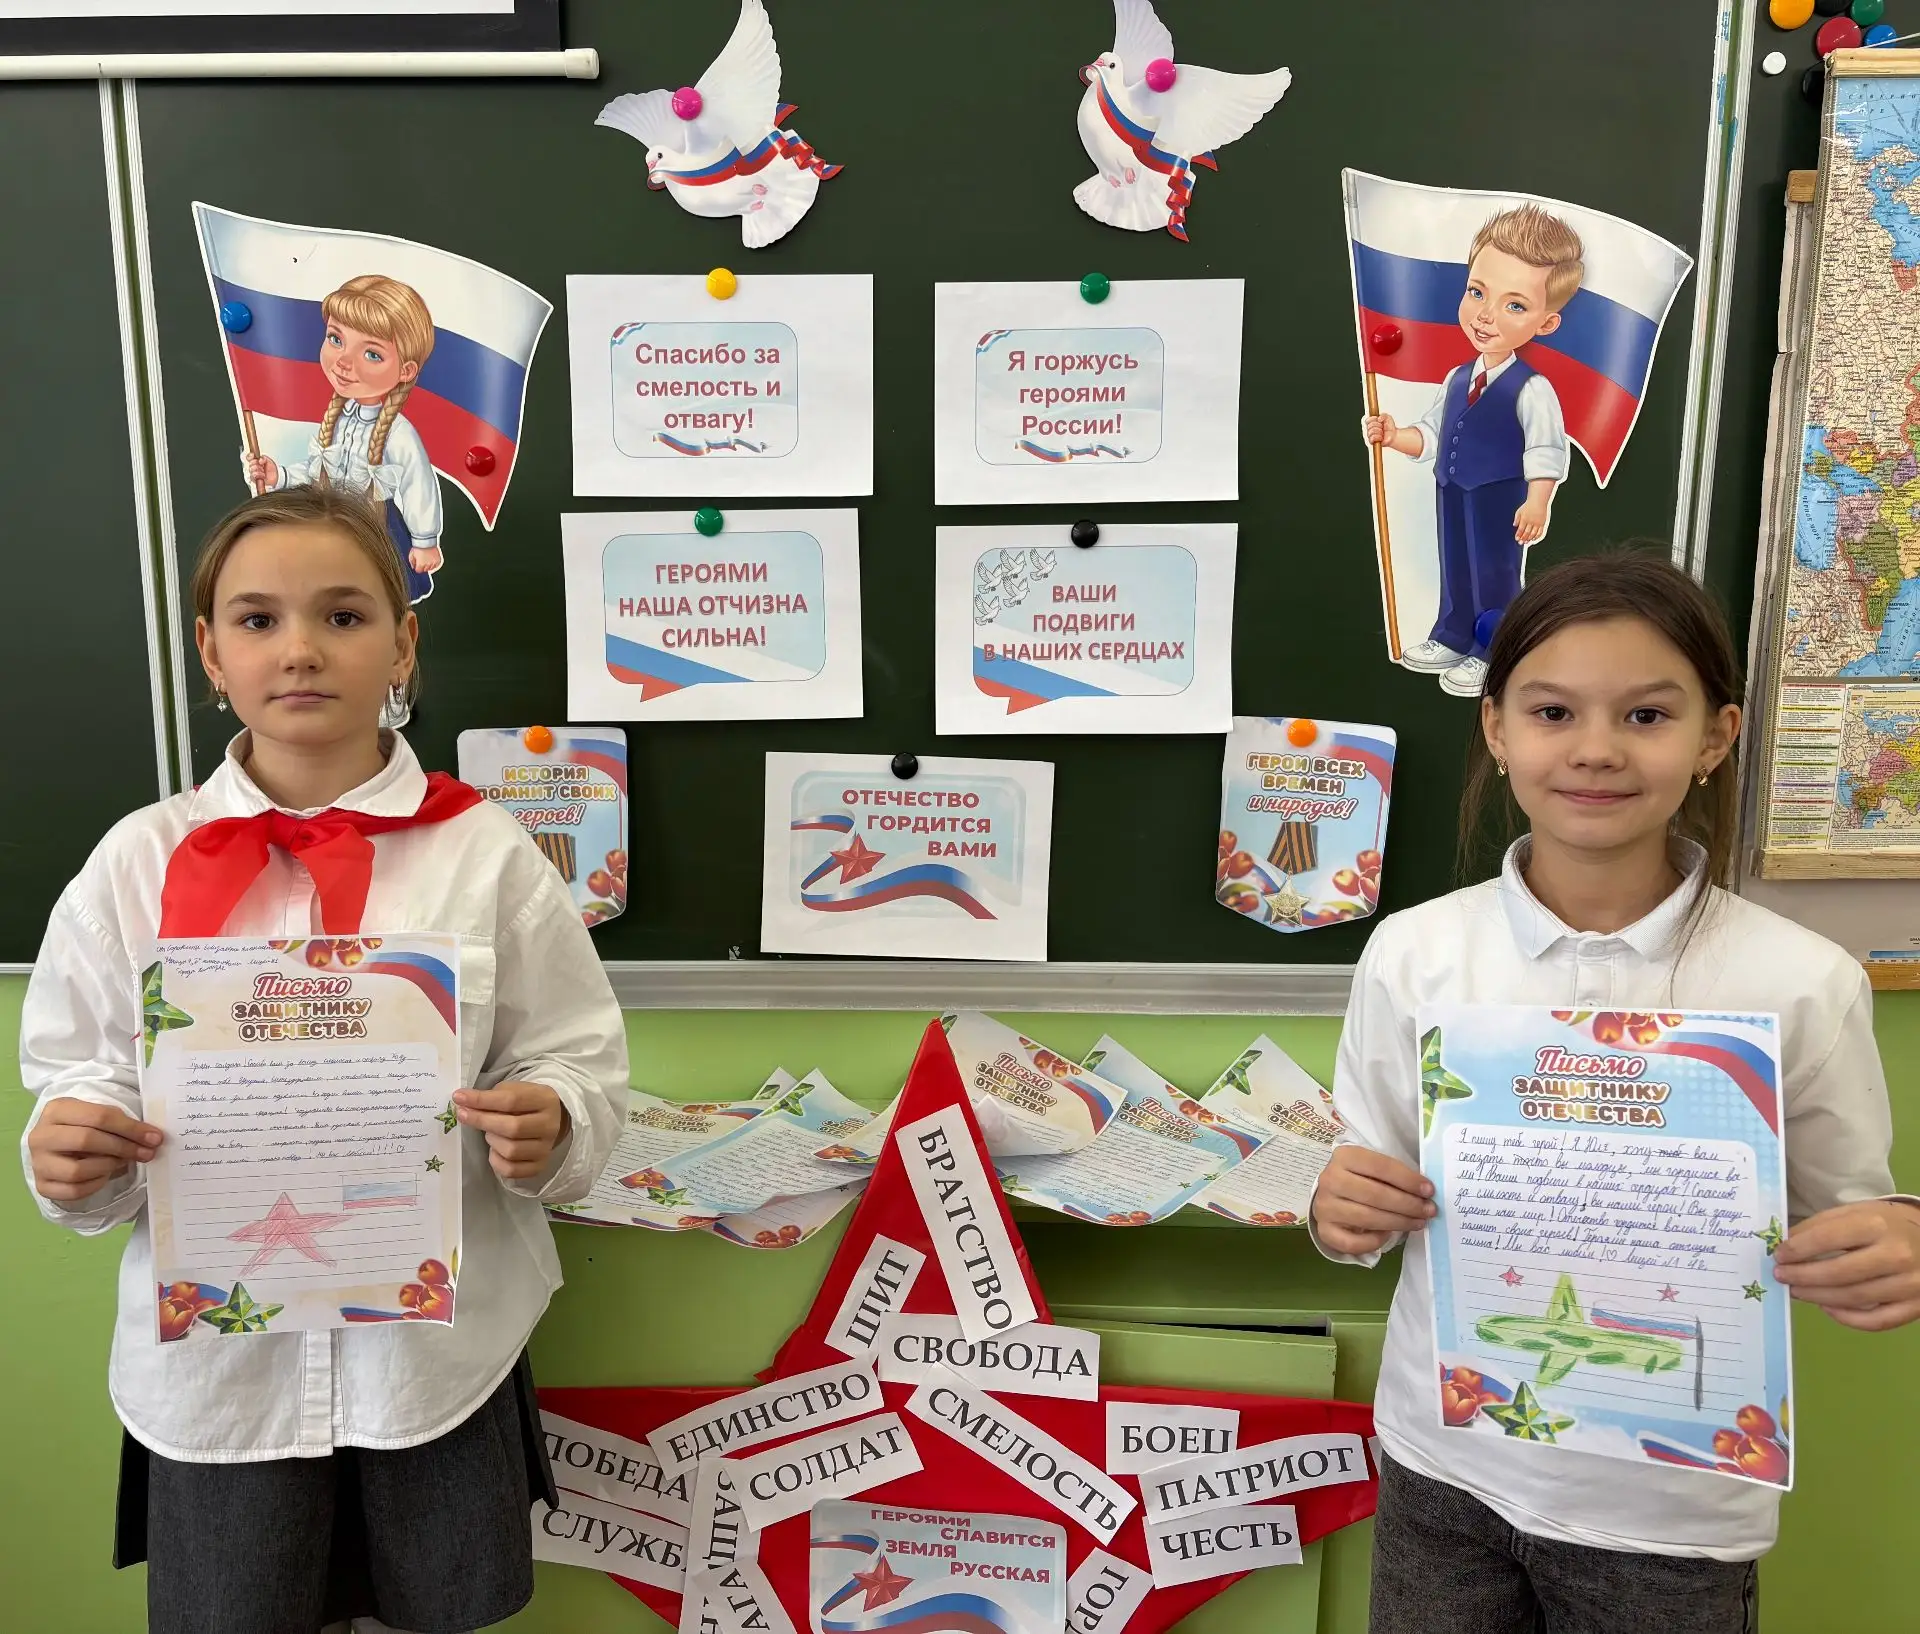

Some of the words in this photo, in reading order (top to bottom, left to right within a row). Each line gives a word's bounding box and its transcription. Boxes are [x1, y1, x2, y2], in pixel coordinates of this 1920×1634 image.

[635, 343, 746, 364] Спасибо
[754, 348, 780, 364] за
[1007, 350, 1025, 371] Я
[1034, 352, 1139, 375] горжусь
[636, 380, 758, 397] смелость
[766, 380, 781, 396] и
[1019, 386, 1126, 408] героями
[664, 408, 753, 434] отвагу!
[1022, 414, 1122, 436] России!
[655, 562, 768, 584] ГЕРОЯМИ
[619, 596, 693, 617] НАША
[698, 594, 808, 615] ОТЧИЗНА
[1052, 584, 1117, 603] ВАШИ
[1033, 613, 1135, 635] ПОДВИГИ
[662, 625, 766, 648] СИЛЬНА!
[983, 643, 996, 661] В
[1002, 642, 1083, 661] НАШИХ
[1088, 641, 1185, 663] СЕРДЦАХ
[503, 765, 588, 782] ИСТОРИЯ
[1248, 754, 1308, 772] ГЕРОИ
[1313, 758, 1365, 778] ВСЕХ
[477, 785, 555, 801] ПОМНИТ
[558, 784, 618, 800] СВОИХ
[1262, 773, 1343, 794] ВРЕМЕН
[842, 789, 980, 808] ОТЕЧЕСТВО
[1248, 796, 1263, 810] и
[1264, 797, 1357, 820] народов!
[515, 805, 585, 830] героев!
[867, 814, 991, 834] ГОРДИТСЯ
[927, 840, 997, 858] ВАМИ
[254, 973, 351, 999] Письмо
[233, 1000, 370, 1020] ЗАЩИТНИКУ
[240, 1019, 365, 1040] ОТЕЧЕСТВА
[995, 1053, 1051, 1090] Письмо
[1536, 1047, 1645, 1078] Письмо
[975, 1076, 1046, 1115] ОТЕЧЕСТВА
[977, 1062, 1057, 1106] ЗАЩИТНИКУ
[1513, 1077, 1669, 1102] ЗАЩИТНИКУ
[1121, 1102, 1203, 1138] ЗАЩИТНИКУ
[1139, 1097, 1198, 1129] Письмо
[1521, 1100, 1664, 1126] ОТЕЧЕСТВА
[1118, 1113, 1191, 1142] ОТЕЧЕСТВА
[918, 1126, 1013, 1331] БРАТСТВО
[893, 1335, 1092, 1380] СВОБОДА
[666, 1373, 871, 1463] ЕДИНСТВО
[749, 1425, 903, 1502] СОЛДАТ
[928, 1388, 1117, 1531] СМЕЛОСТЬ
[1155, 1447, 1353, 1511] ПАТРИОТ
[871, 1509, 971, 1527] ГЕРОЯМИ
[542, 1509, 687, 1573] СЛУЖБ
[885, 1540, 957, 1559] ЗЕМЛЯ
[940, 1527, 1056, 1548] СЛАВИТСЯ
[1160, 1522, 1292, 1561] ЧЕСТЬ
[950, 1561, 1050, 1583] РУССКАЯ
[719, 1568, 770, 1630] АГА
